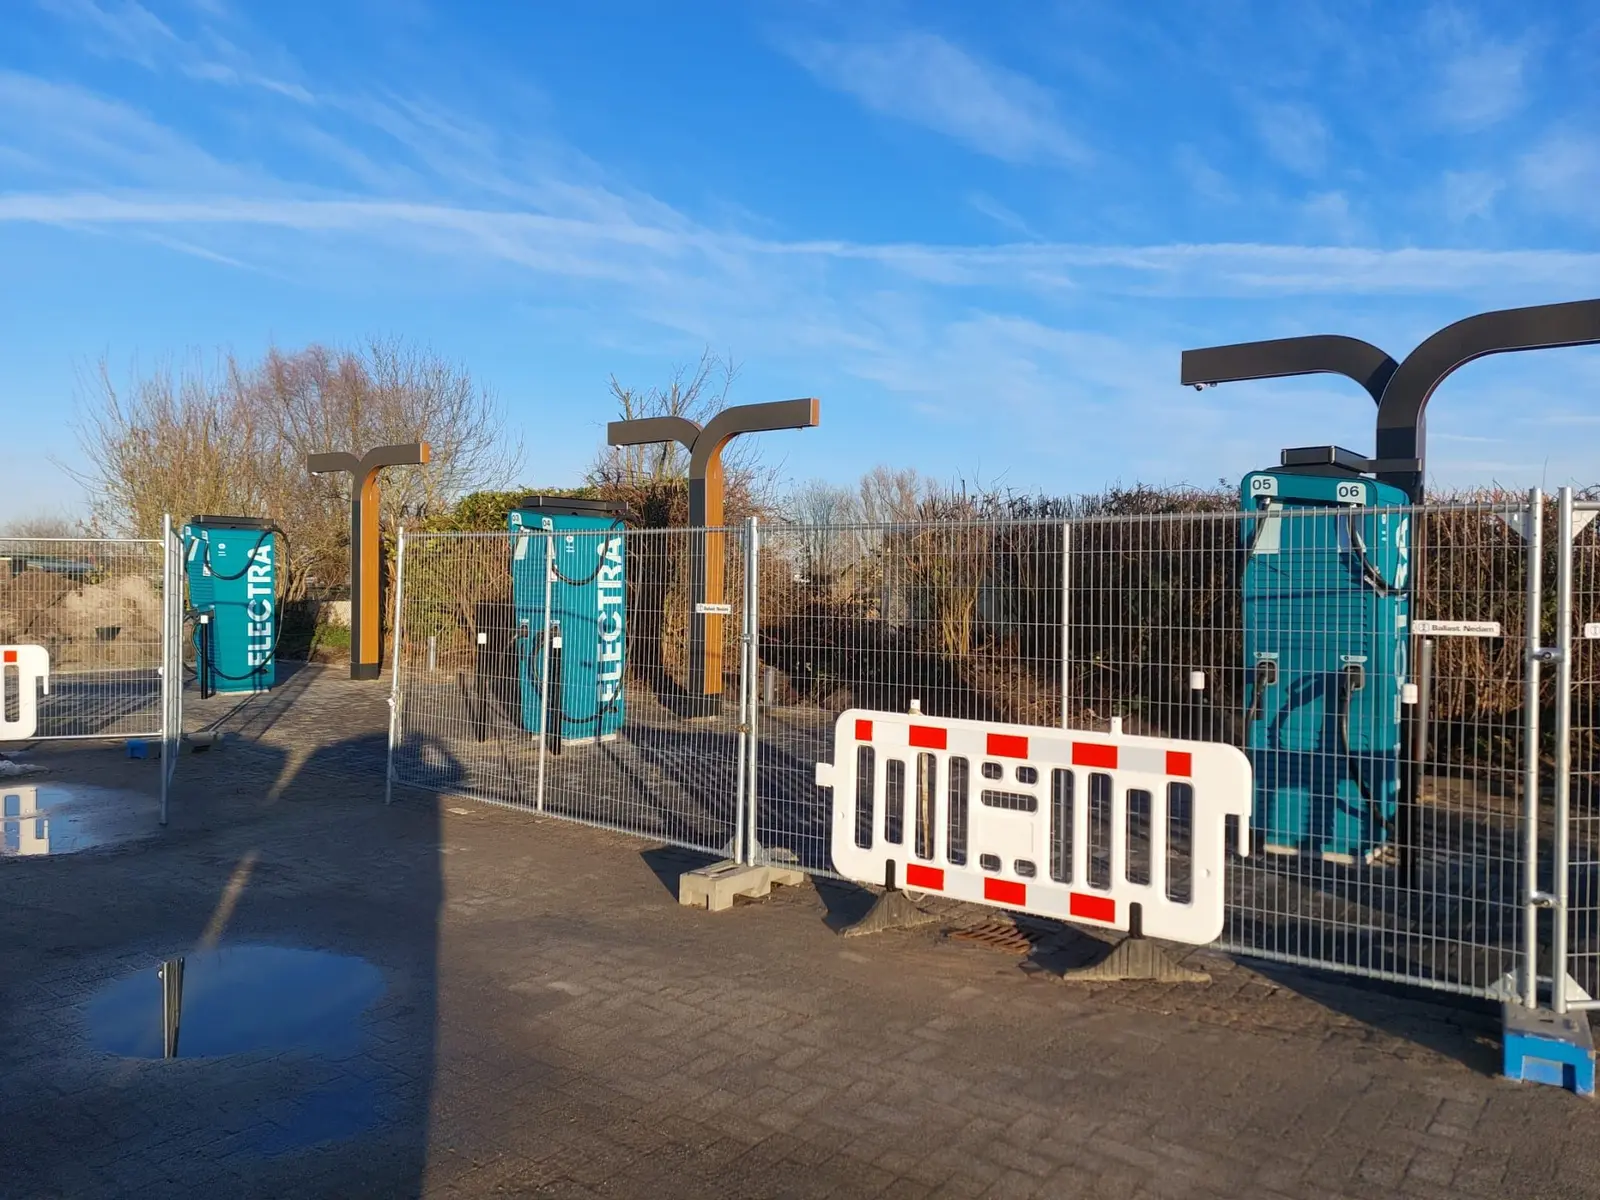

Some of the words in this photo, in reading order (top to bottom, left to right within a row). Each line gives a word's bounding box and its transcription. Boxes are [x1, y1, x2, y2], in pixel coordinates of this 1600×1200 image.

[1252, 479, 1272, 490] 05
[1338, 486, 1360, 498] 06
[247, 544, 272, 666] ELECTRA
[598, 537, 622, 702] ELECTRA
[1431, 624, 1461, 632] Ballast
[1464, 625, 1494, 633] Nedam
